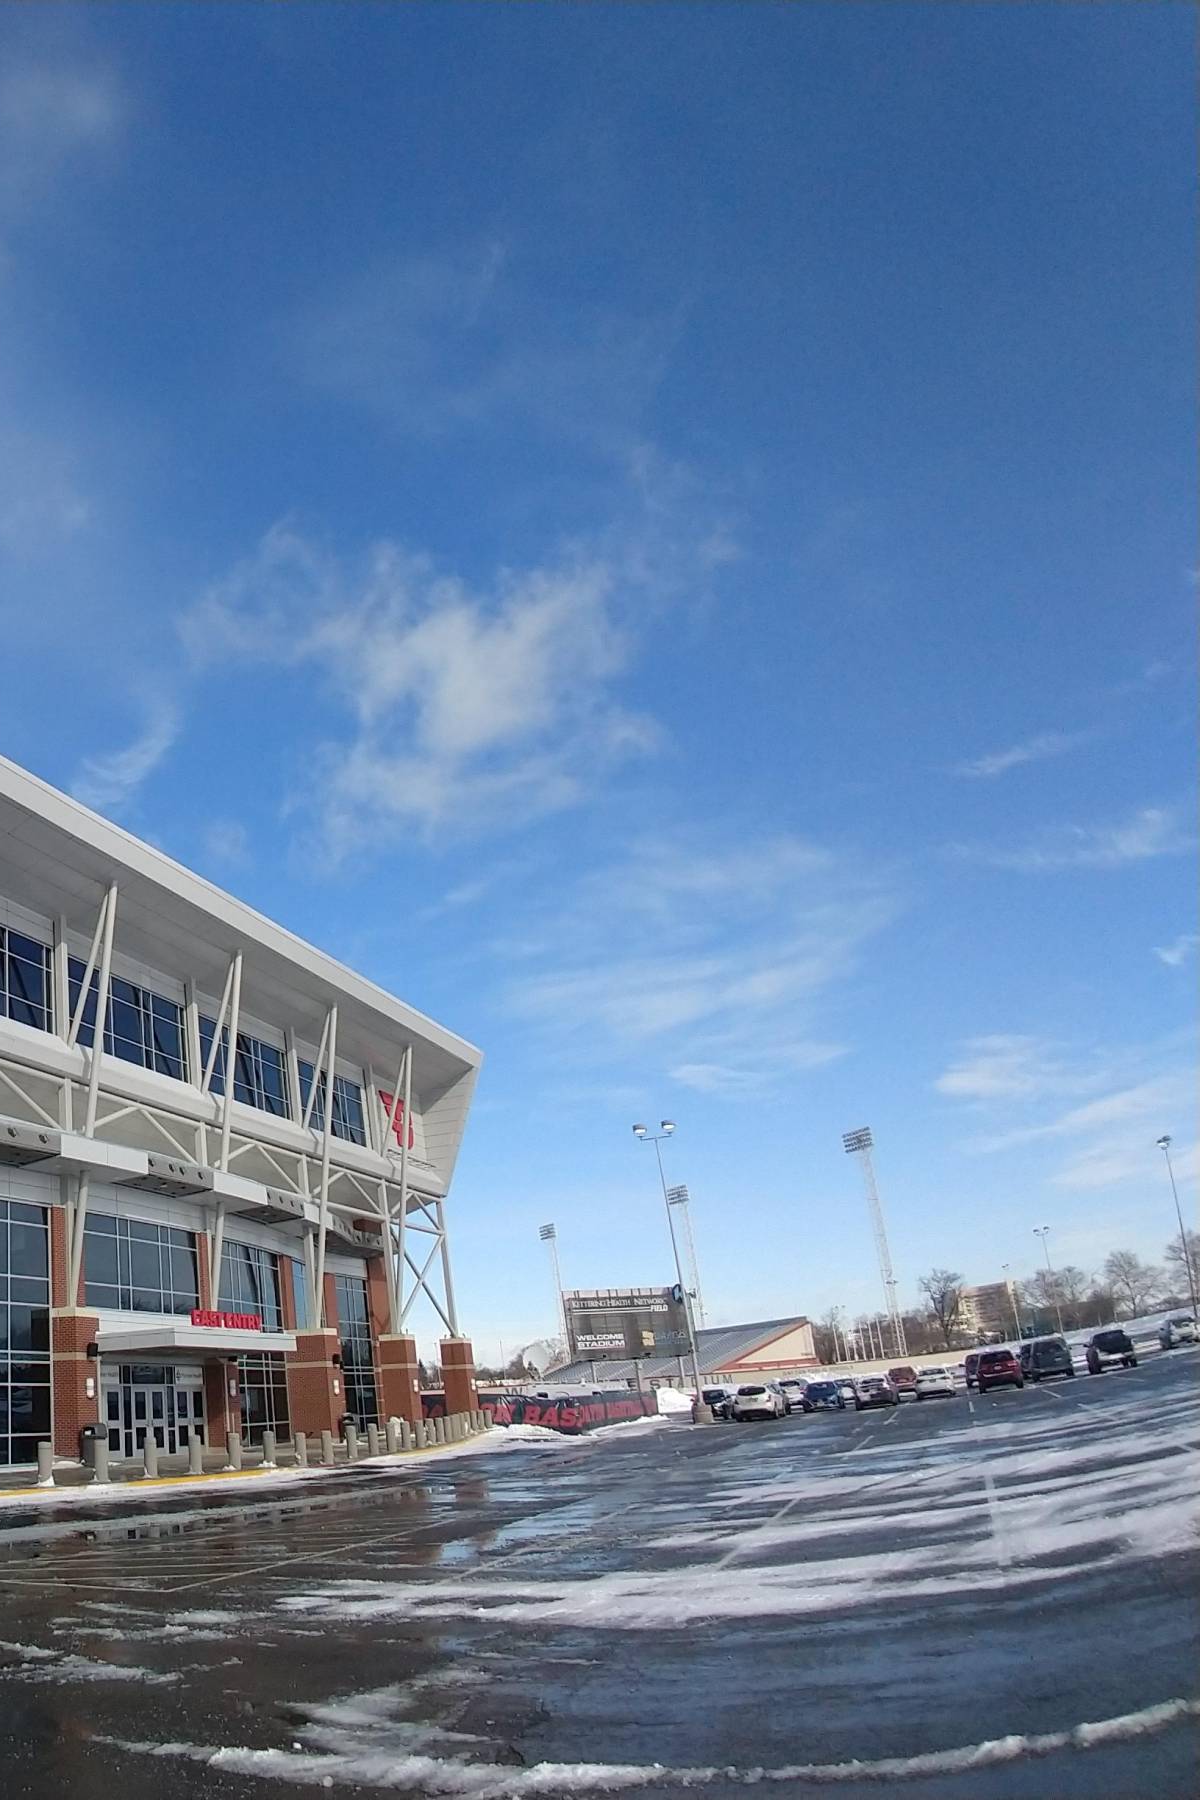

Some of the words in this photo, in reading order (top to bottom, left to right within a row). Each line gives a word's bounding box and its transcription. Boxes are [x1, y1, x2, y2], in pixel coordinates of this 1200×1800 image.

[572, 1300, 606, 1309] KETTERING
[607, 1298, 631, 1307] HEALTH
[634, 1297, 666, 1306] NETWORK
[650, 1304, 668, 1312] FIELD
[191, 1310, 223, 1328] EAST
[224, 1312, 262, 1331] ENTRY
[576, 1333, 625, 1341] WELCOME
[577, 1340, 626, 1349] STADIUM
